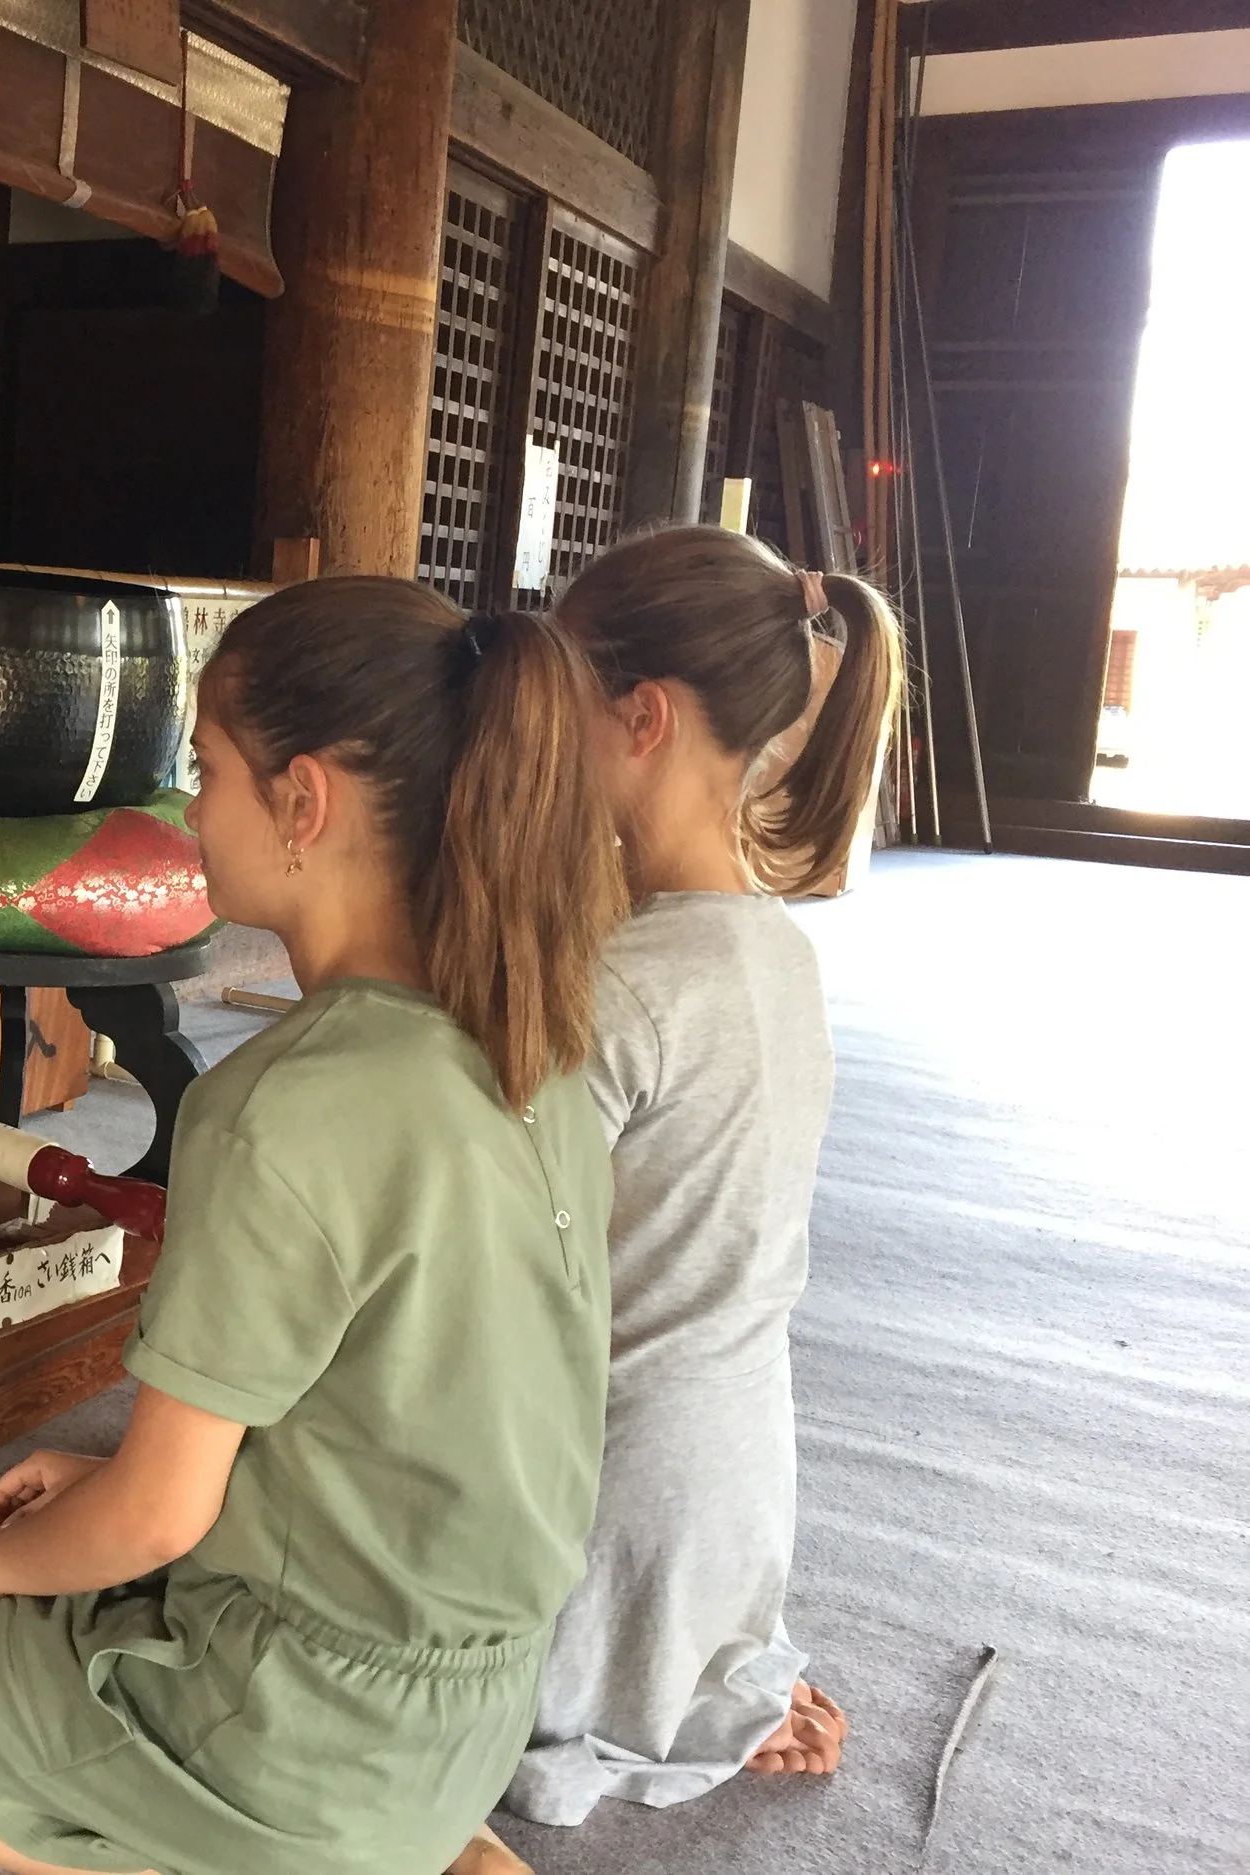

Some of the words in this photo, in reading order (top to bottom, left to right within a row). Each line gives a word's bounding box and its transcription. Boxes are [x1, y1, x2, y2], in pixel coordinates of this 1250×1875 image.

[80, 632, 118, 798] 矢印の所を打って下さい
